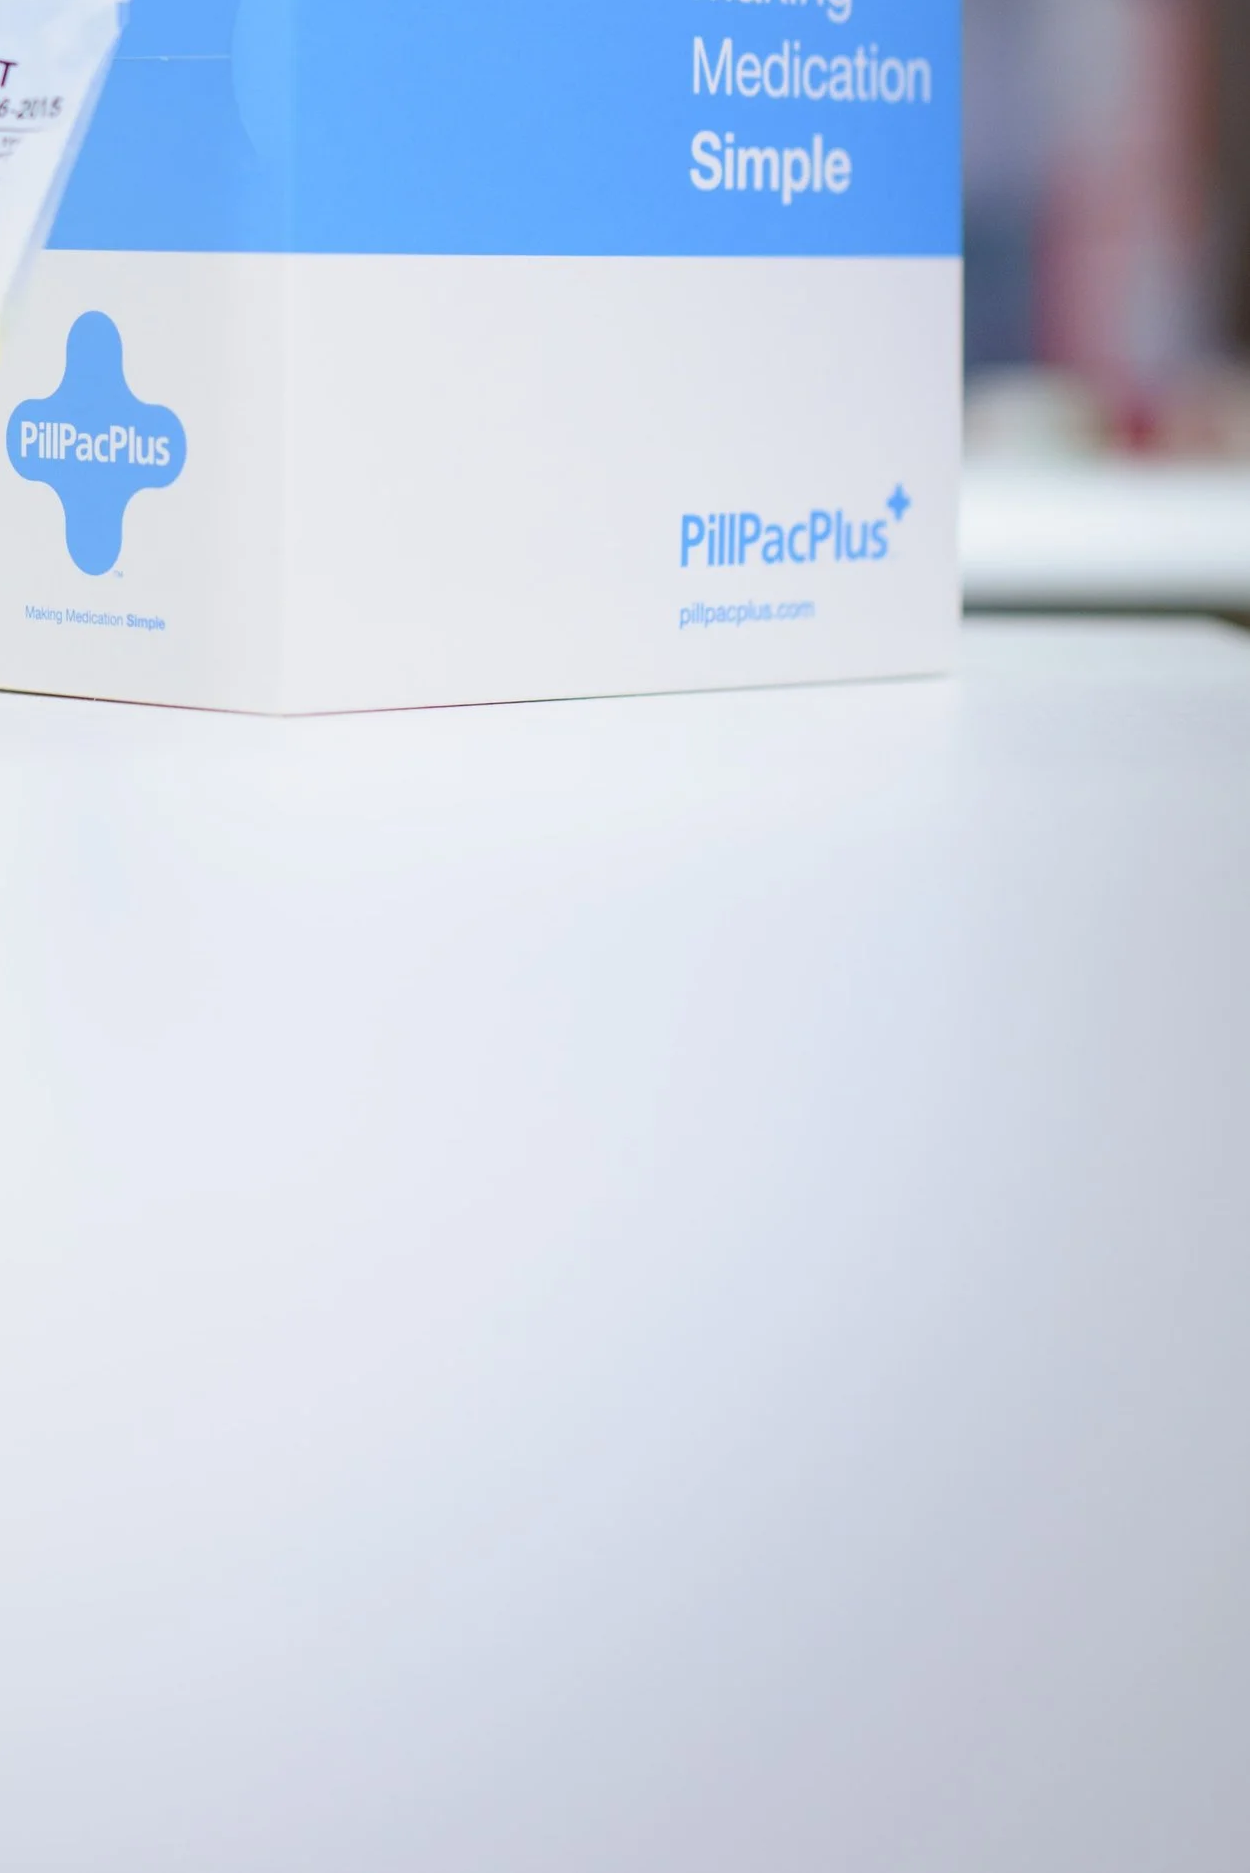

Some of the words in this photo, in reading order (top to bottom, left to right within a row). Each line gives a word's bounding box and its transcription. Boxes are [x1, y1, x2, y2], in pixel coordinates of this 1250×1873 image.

[693, 36, 932, 104] Medication
[690, 129, 852, 206] Simple
[20, 420, 171, 466] PillPacPlus
[680, 509, 889, 568] PillPacPlus
[25, 605, 63, 624] Making
[65, 609, 124, 627] Medication
[126, 613, 166, 631] Simple
[679, 600, 816, 629] pillpacplus.com
